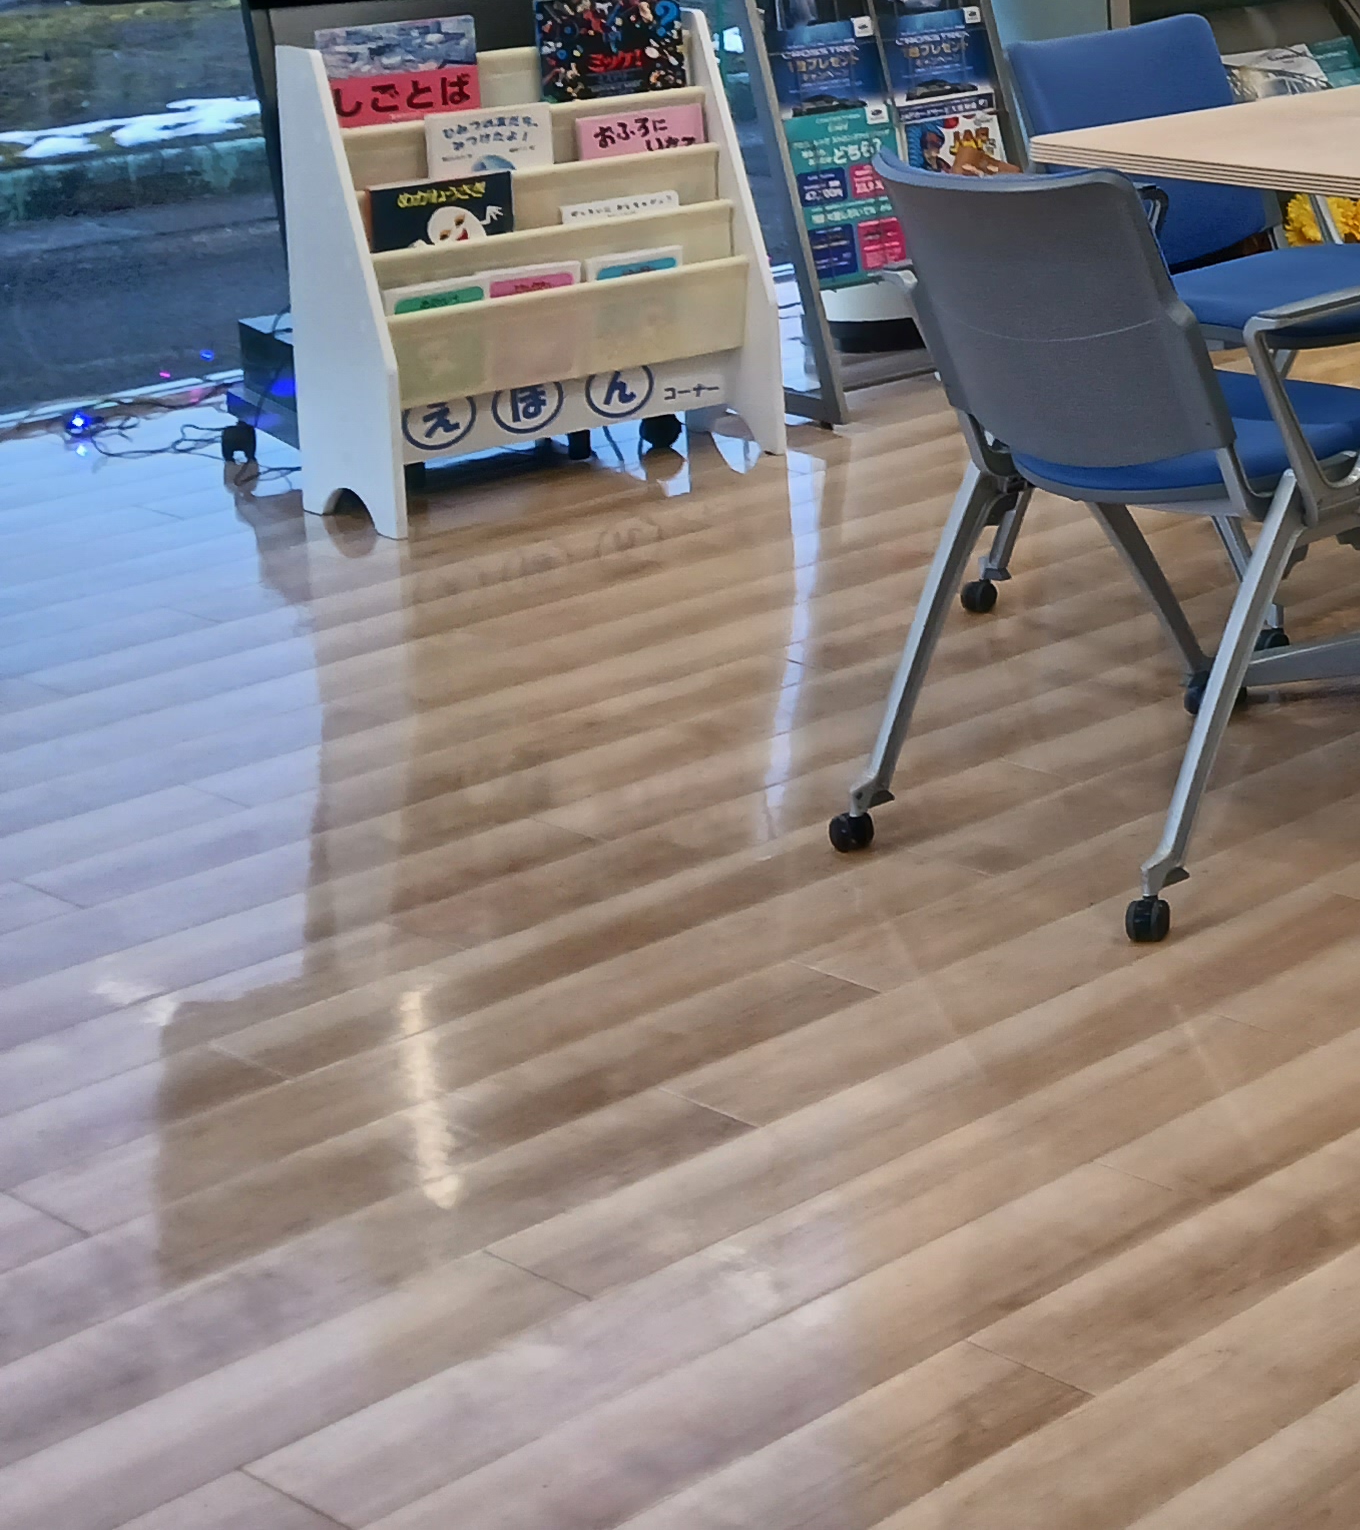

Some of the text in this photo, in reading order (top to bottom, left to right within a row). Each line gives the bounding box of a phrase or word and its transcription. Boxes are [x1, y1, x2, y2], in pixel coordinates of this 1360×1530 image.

[334, 72, 472, 118] しごとば
[593, 117, 668, 149] おふろに
[664, 384, 720, 400] コーナー
